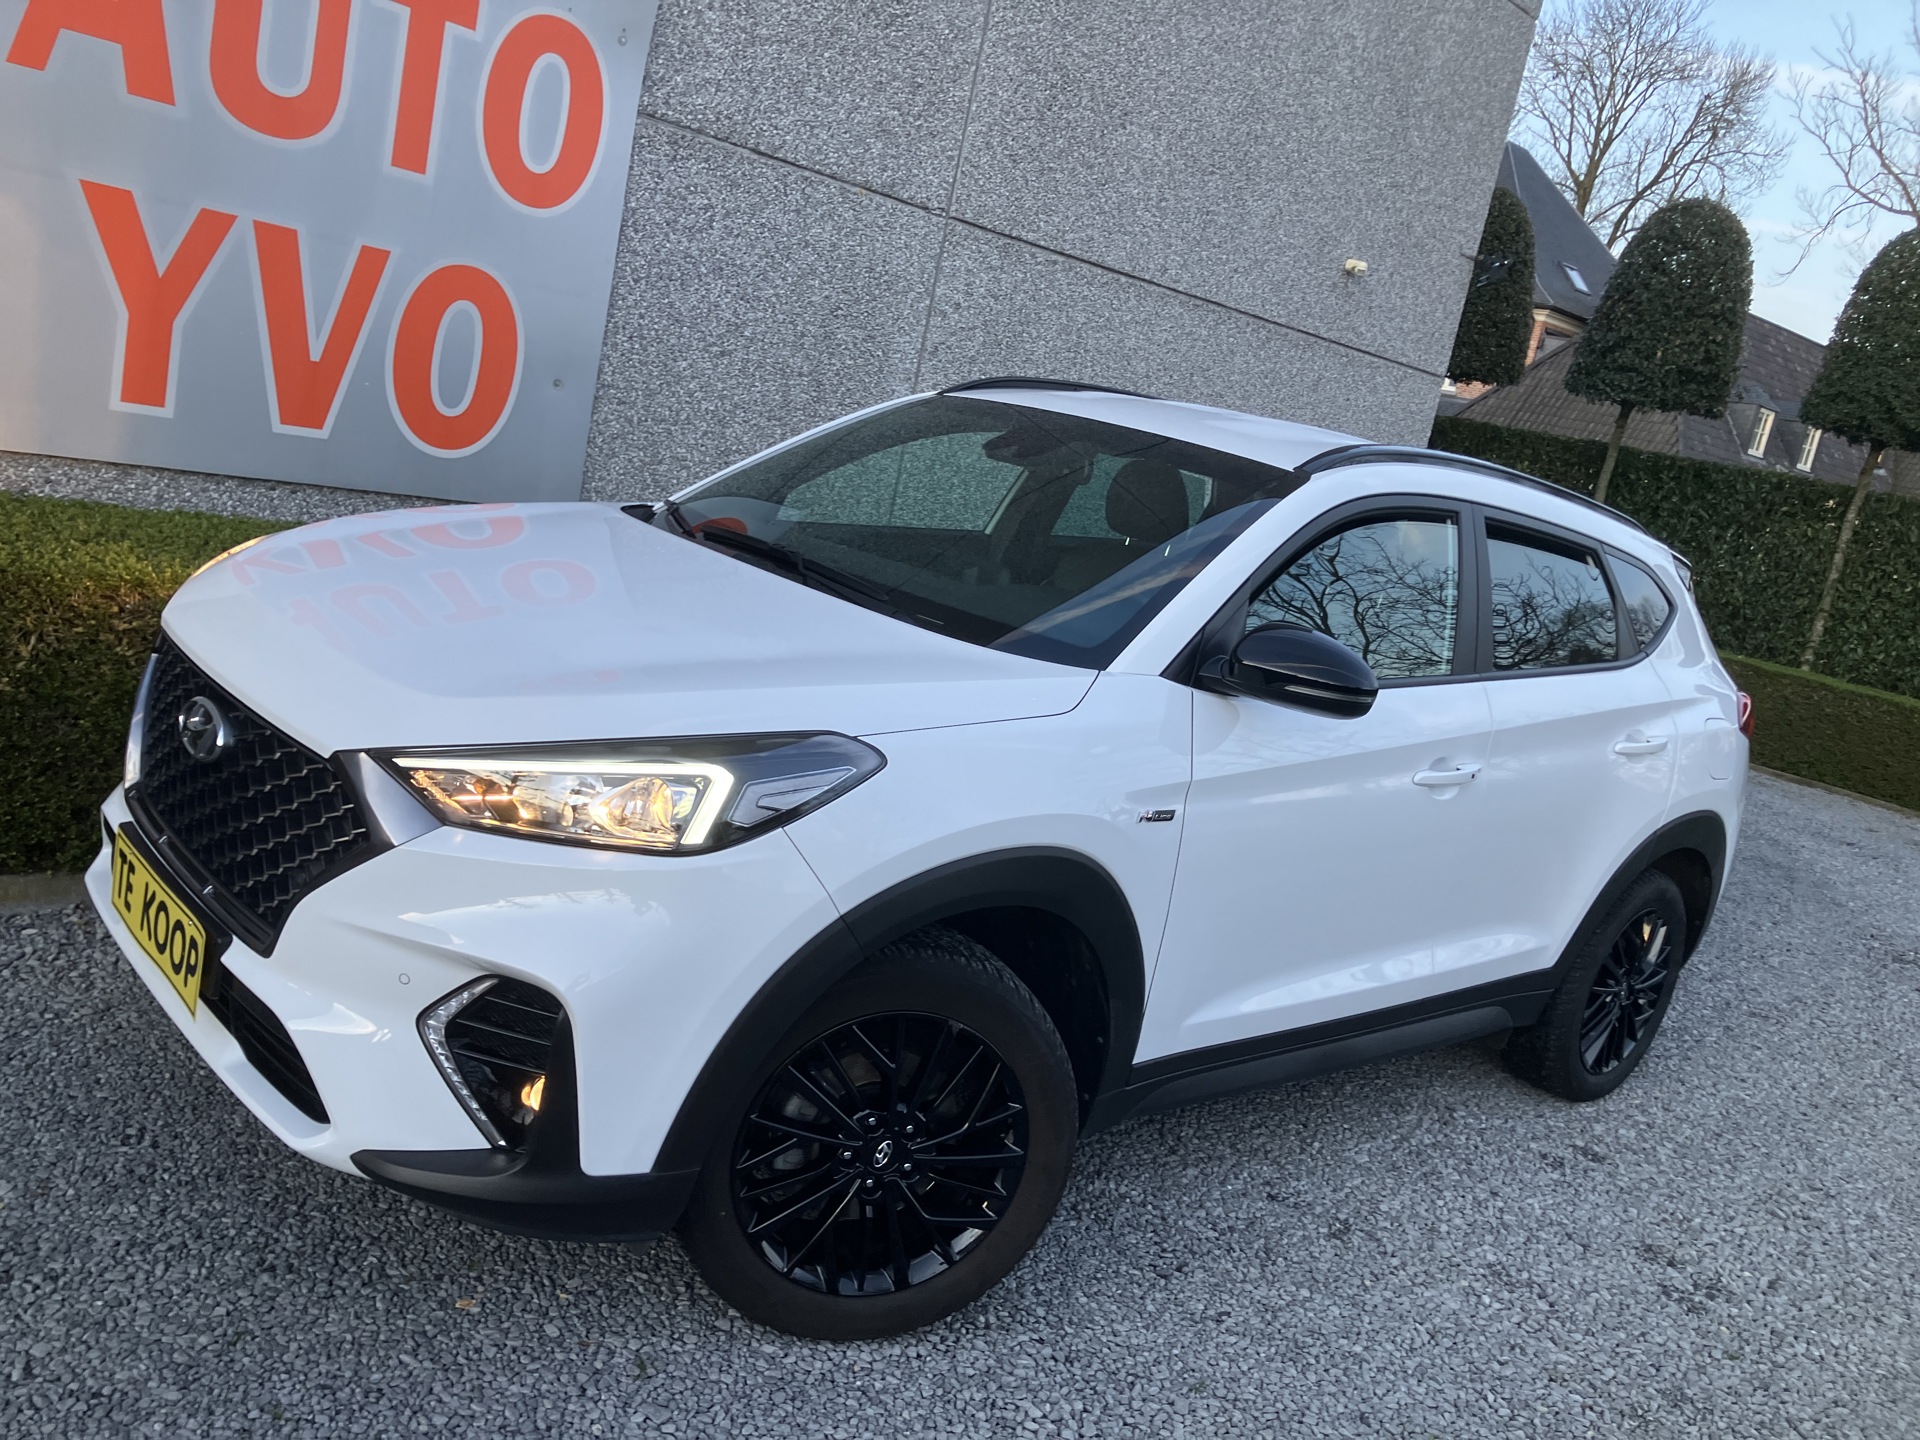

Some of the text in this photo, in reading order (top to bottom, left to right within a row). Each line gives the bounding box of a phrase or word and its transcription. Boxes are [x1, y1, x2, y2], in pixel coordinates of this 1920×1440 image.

[78, 177, 519, 453] YVO
[118, 847, 199, 988] TE KOOP
